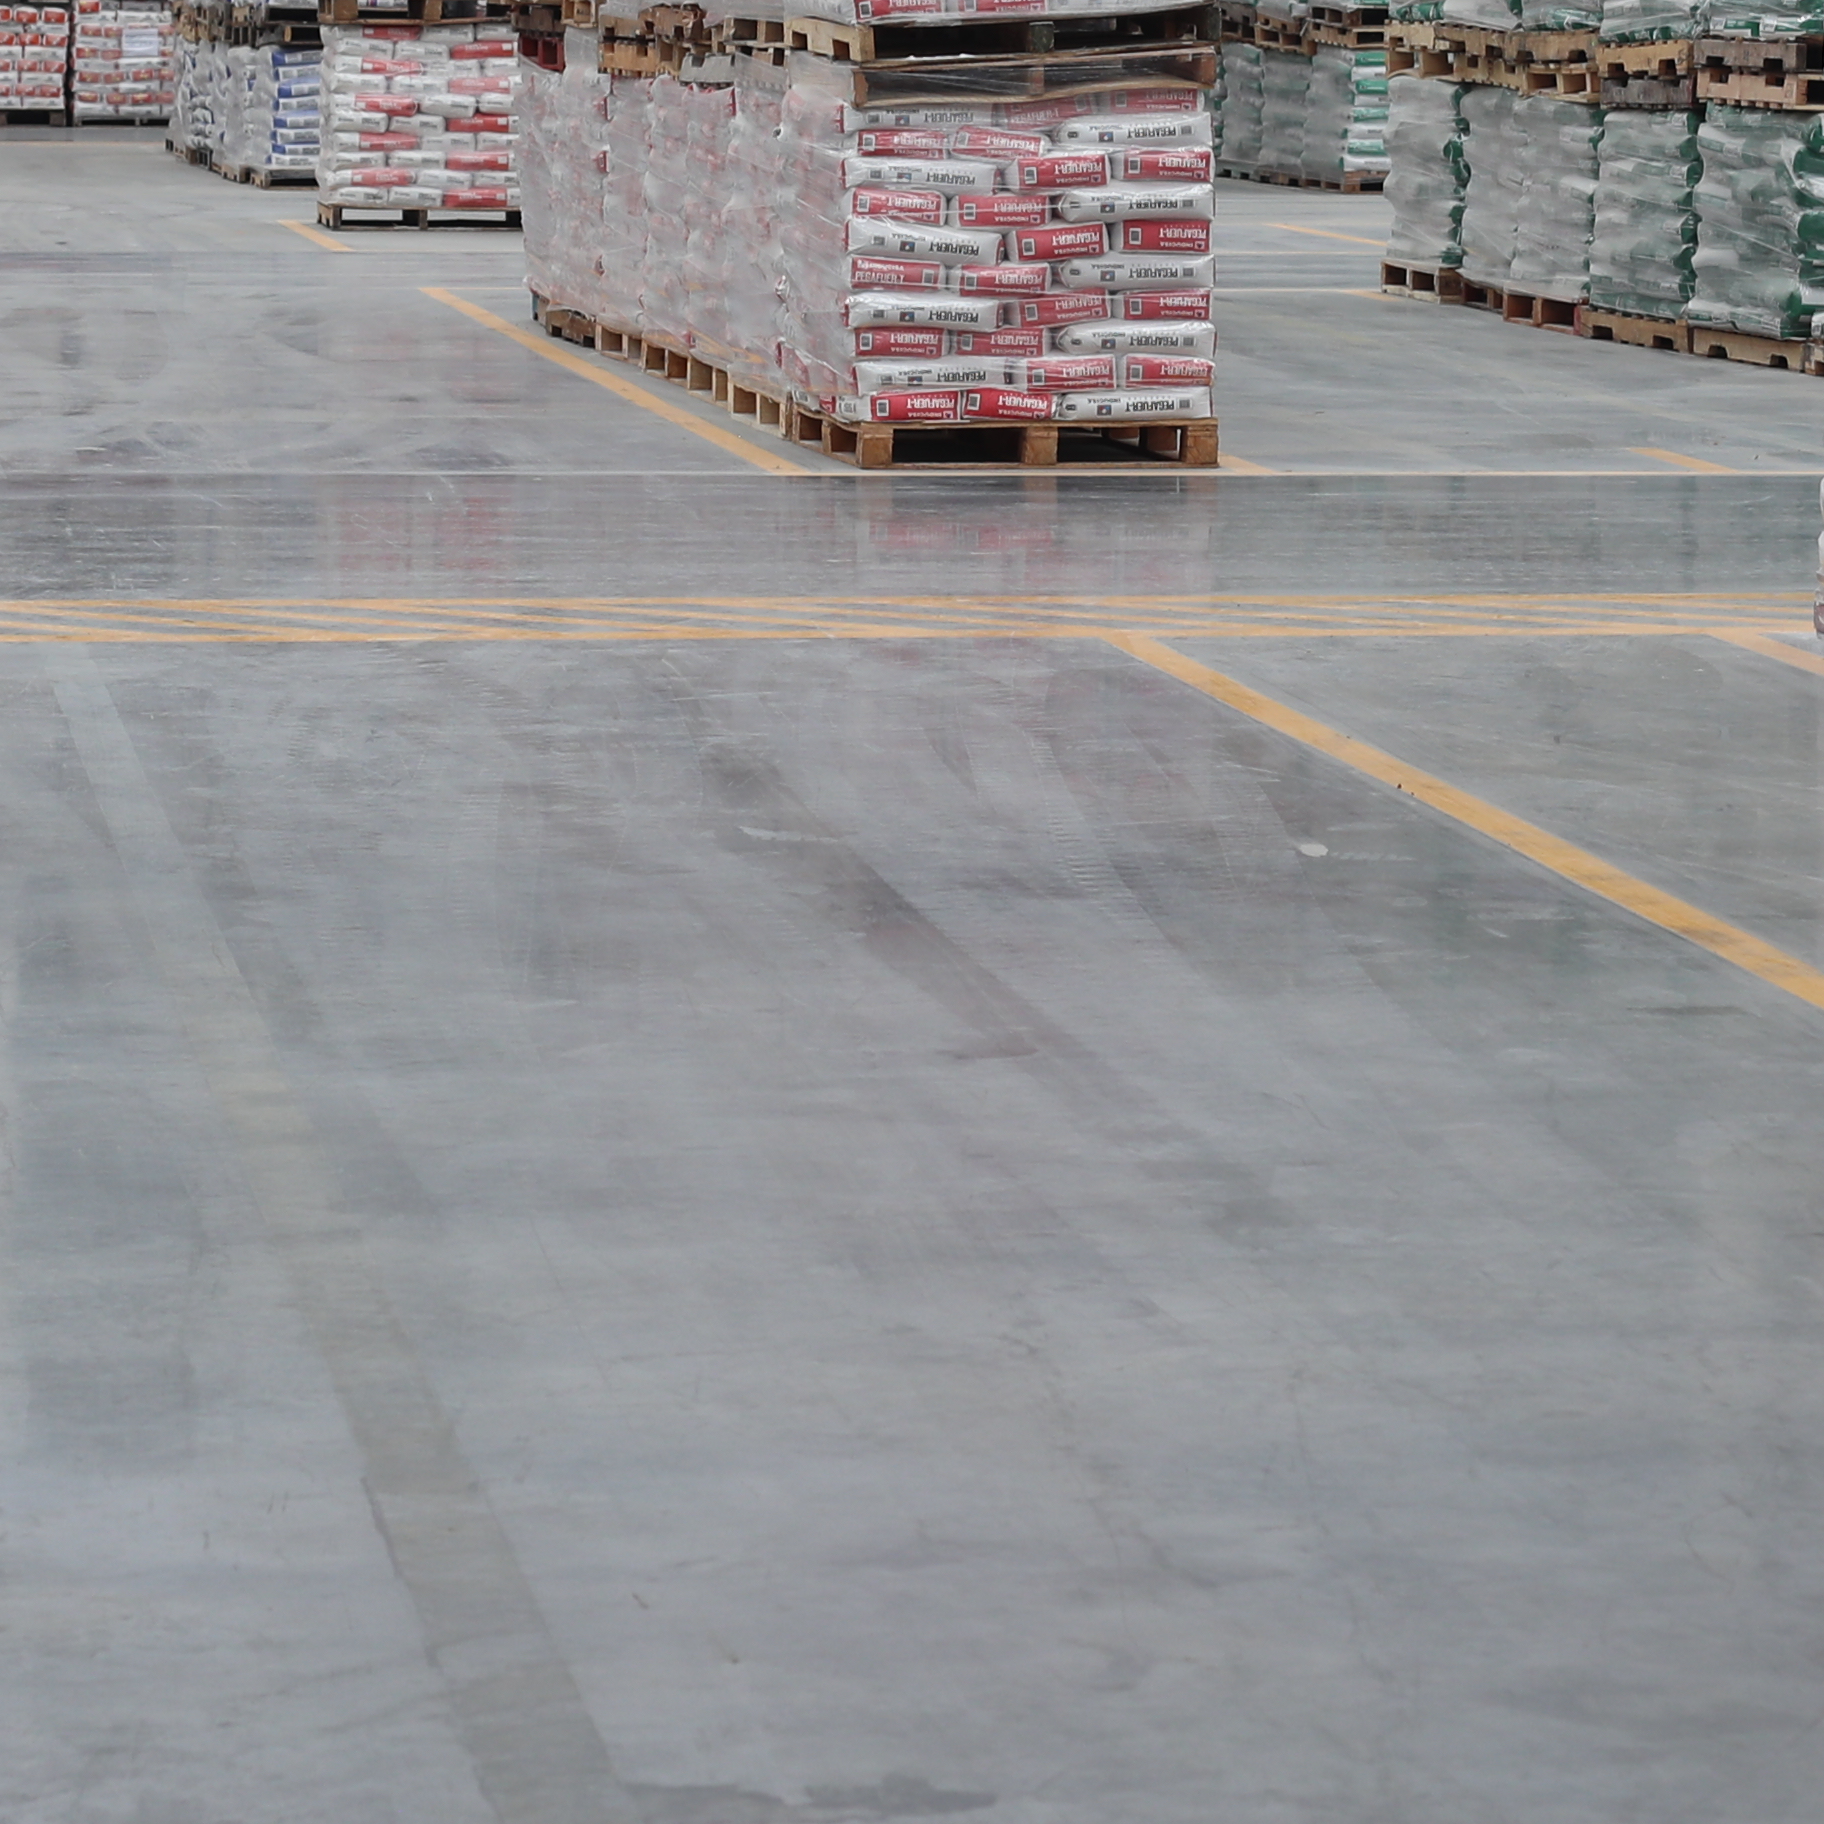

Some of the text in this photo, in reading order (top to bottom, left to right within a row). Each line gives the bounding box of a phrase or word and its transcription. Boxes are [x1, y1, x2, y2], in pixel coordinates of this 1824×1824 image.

[1127, 126, 1176, 138] PEGAFUER-T
[1158, 157, 1206, 169] PEGAFUER-T
[926, 171, 975, 184] PEGAFUER-T
[1159, 228, 1207, 239] PEGAFUER-T
[928, 240, 979, 255] PEGAFUER-T
[1129, 266, 1178, 278] PEGAFUER-T
[1159, 296, 1208, 308] PEGAFUER-T
[928, 310, 979, 322] PEGAFUER-T
[890, 333, 939, 344] PEGAFUER-T
[990, 333, 1039, 344] PEGAFUER-T
[1129, 334, 1178, 346] PEGAFUER-T
[906, 396, 955, 408] PEGAFUER-T
[1125, 398, 1175, 411] PEGAFUER-T
